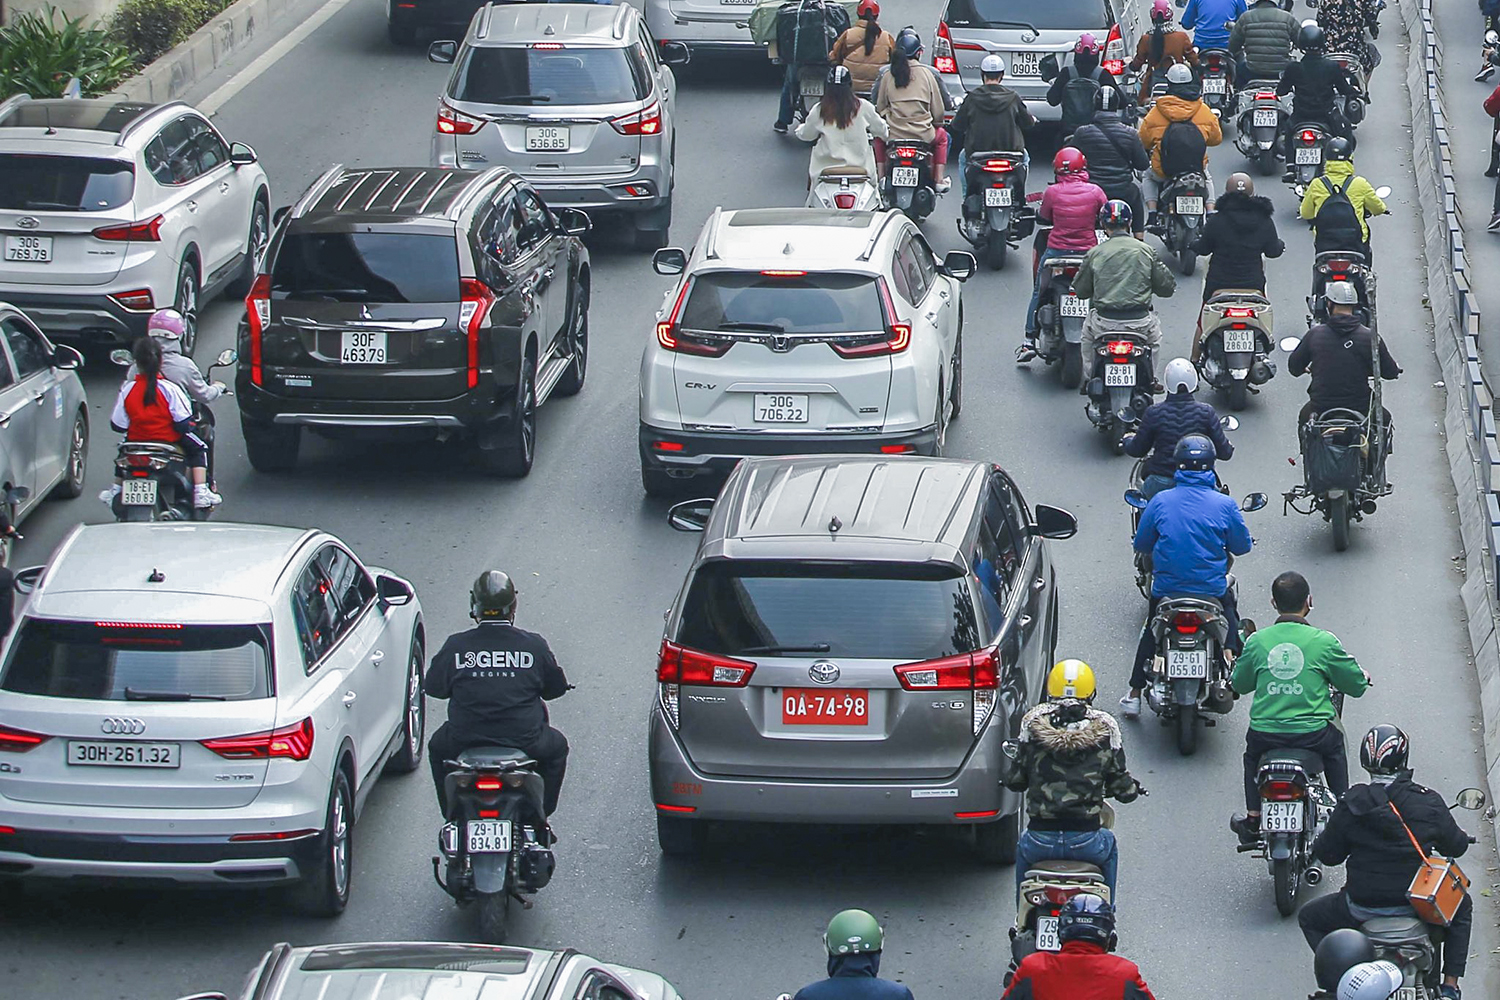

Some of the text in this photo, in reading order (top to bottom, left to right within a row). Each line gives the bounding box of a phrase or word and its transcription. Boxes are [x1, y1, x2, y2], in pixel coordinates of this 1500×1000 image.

[538, 129, 557, 137] 30G
[530, 139, 564, 148] 536.85
[19, 237, 39, 248] 30G
[10, 248, 46, 260] 769.79
[1062, 306, 1087, 316] 689.55
[352, 333, 376, 347] 30F
[1226, 341, 1252, 350] 286.02
[342, 348, 384, 362] 463.79
[1109, 366, 1130, 375] 29-B1
[685, 382, 717, 390] CR-V
[1107, 376, 1133, 385] 886.01
[770, 396, 794, 407] 30G
[760, 409, 803, 420] 706.22
[455, 650, 534, 669] L3GEND
[1173, 653, 1200, 663] 29-G1
[1170, 665, 1203, 676] 055.80
[1266, 679, 1303, 696] Grab
[786, 697, 865, 717] QA-74-98
[77, 745, 171, 764] 30H-261.32
[1268, 803, 1297, 816] 29-Y7
[1267, 817, 1297, 830] 6918
[474, 823, 504, 836] 29-T1
[471, 837, 508, 850] 834.81
